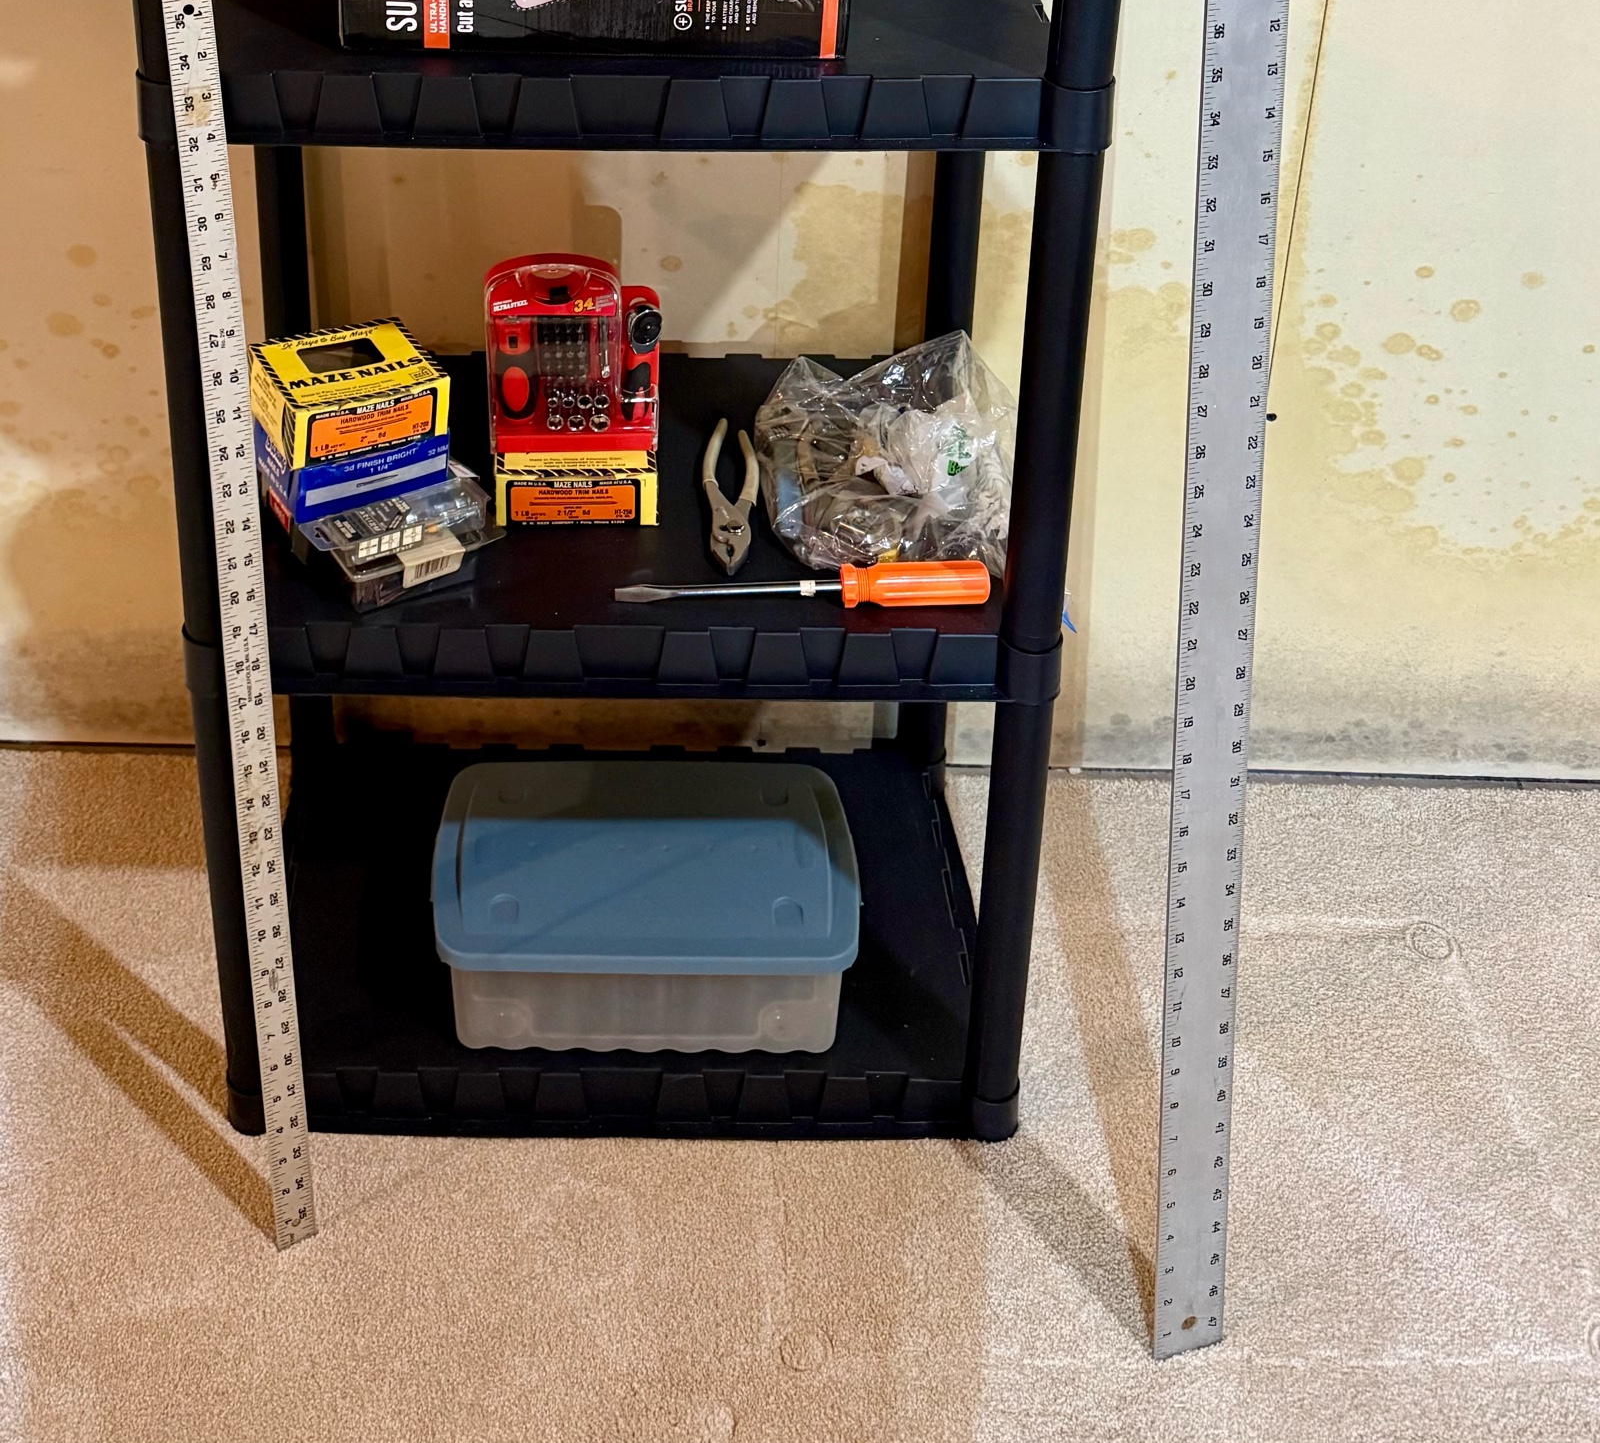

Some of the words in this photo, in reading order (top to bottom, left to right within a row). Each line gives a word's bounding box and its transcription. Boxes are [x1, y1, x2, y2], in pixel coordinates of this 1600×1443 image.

[174, 12, 186, 29] 35
[456, 12, 474, 32] Cut
[1213, 23, 1225, 38] 36
[180, 54, 190, 70] 34
[185, 96, 196, 112] 33
[189, 136, 199, 152] 32
[194, 177, 204, 192] 31
[1206, 196, 1216, 212] 32
[198, 216, 208, 232] 30
[202, 256, 212, 271] 29
[574, 297, 594, 314] 34
[330, 334, 348, 342] Buy
[288, 370, 356, 390] MAZE
[356, 356, 424, 378] NAILS
[340, 413, 375, 425] HARDWOOD
[377, 408, 392, 418] TRIM
[392, 404, 409, 414] NAILS
[356, 404, 374, 414] MAZE
[376, 400, 395, 410] NAILS
[320, 444, 330, 452] LB
[344, 464, 356, 472] 3d
[356, 458, 385, 470] FINISH
[386, 448, 417, 462] BRIGHT
[264, 827, 274, 841] 23
[284, 1053, 292, 1067] 30
[292, 1146, 302, 1160] 33
